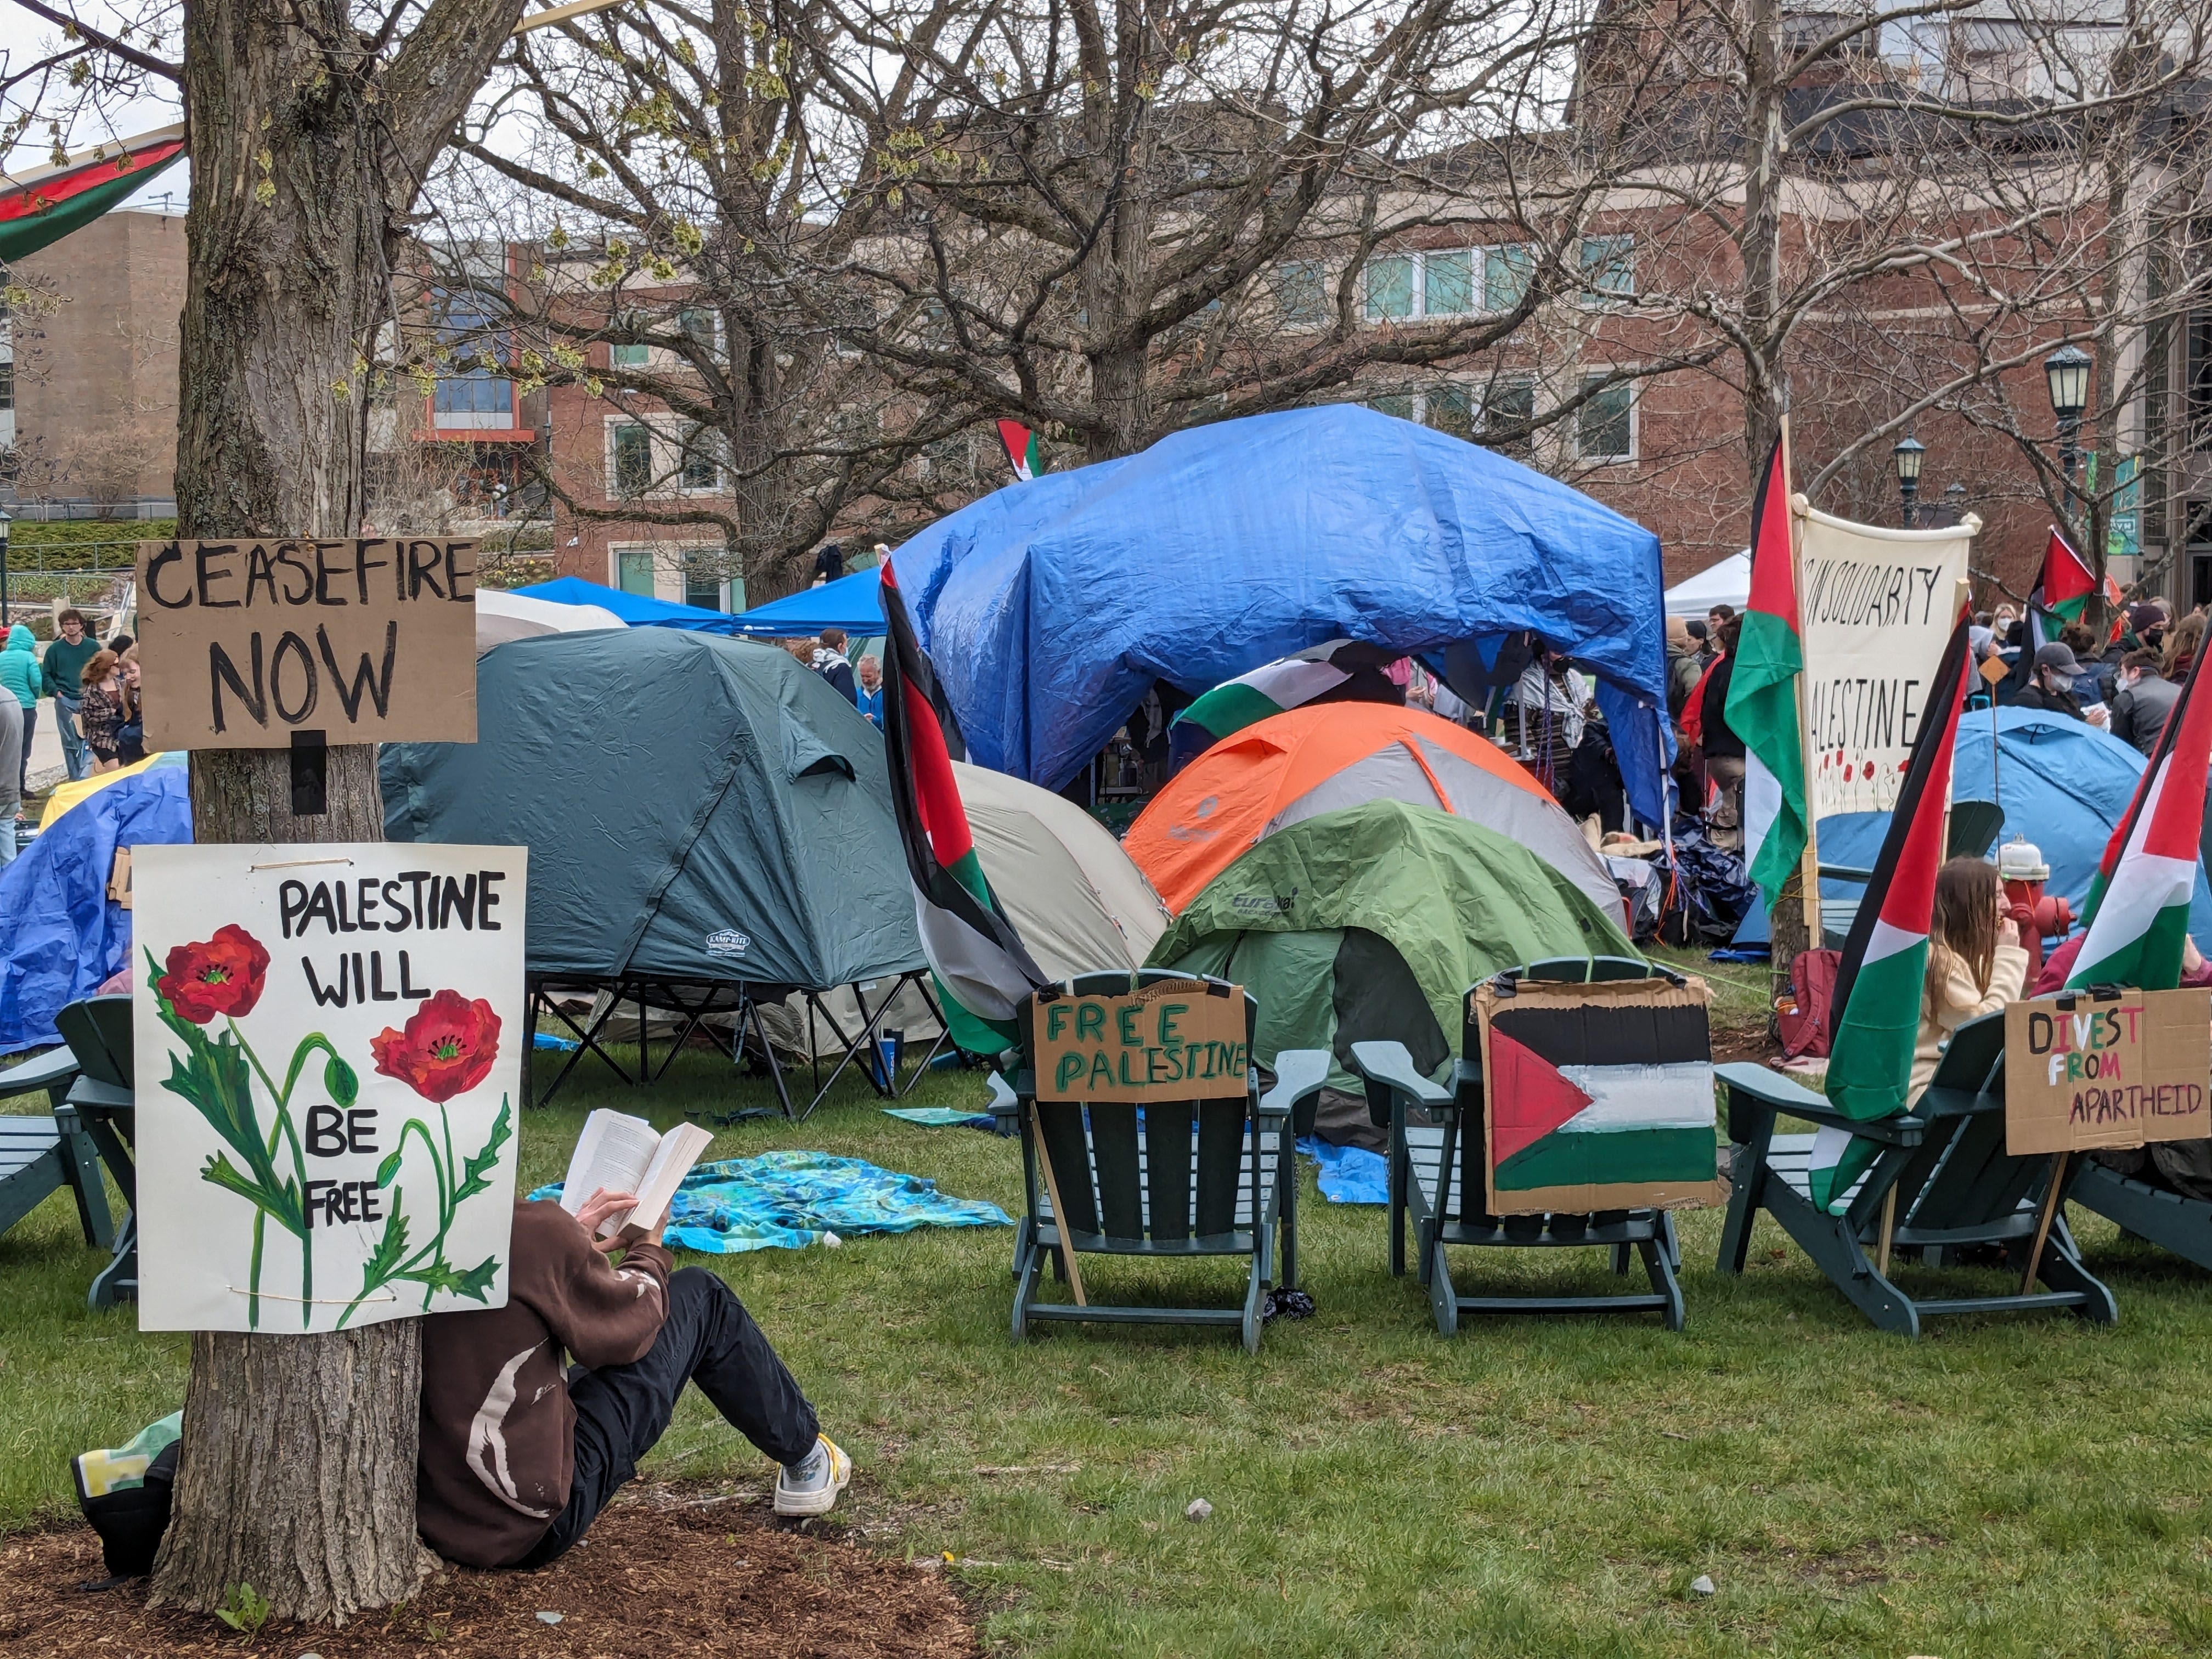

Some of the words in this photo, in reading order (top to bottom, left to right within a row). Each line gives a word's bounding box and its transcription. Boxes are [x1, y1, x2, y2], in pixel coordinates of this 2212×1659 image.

[145, 539, 476, 609] CEASEFIRE
[1821, 560, 1942, 627] SOLIDARITY
[209, 620, 397, 733] NOW
[1811, 678, 1919, 754] ALESTINE
[279, 870, 506, 939] PALESTINE
[302, 950, 431, 1008] WILL
[1047, 1002, 1189, 1047] FREE
[2029, 1007, 2145, 1054] DIVEST
[1055, 1041, 1246, 1093] PALESTINE
[2048, 1052, 2121, 1086] FROM
[2069, 1083, 2202, 1126] APARTHEID
[305, 1105, 379, 1157] BE
[303, 1180, 383, 1230] FREE
